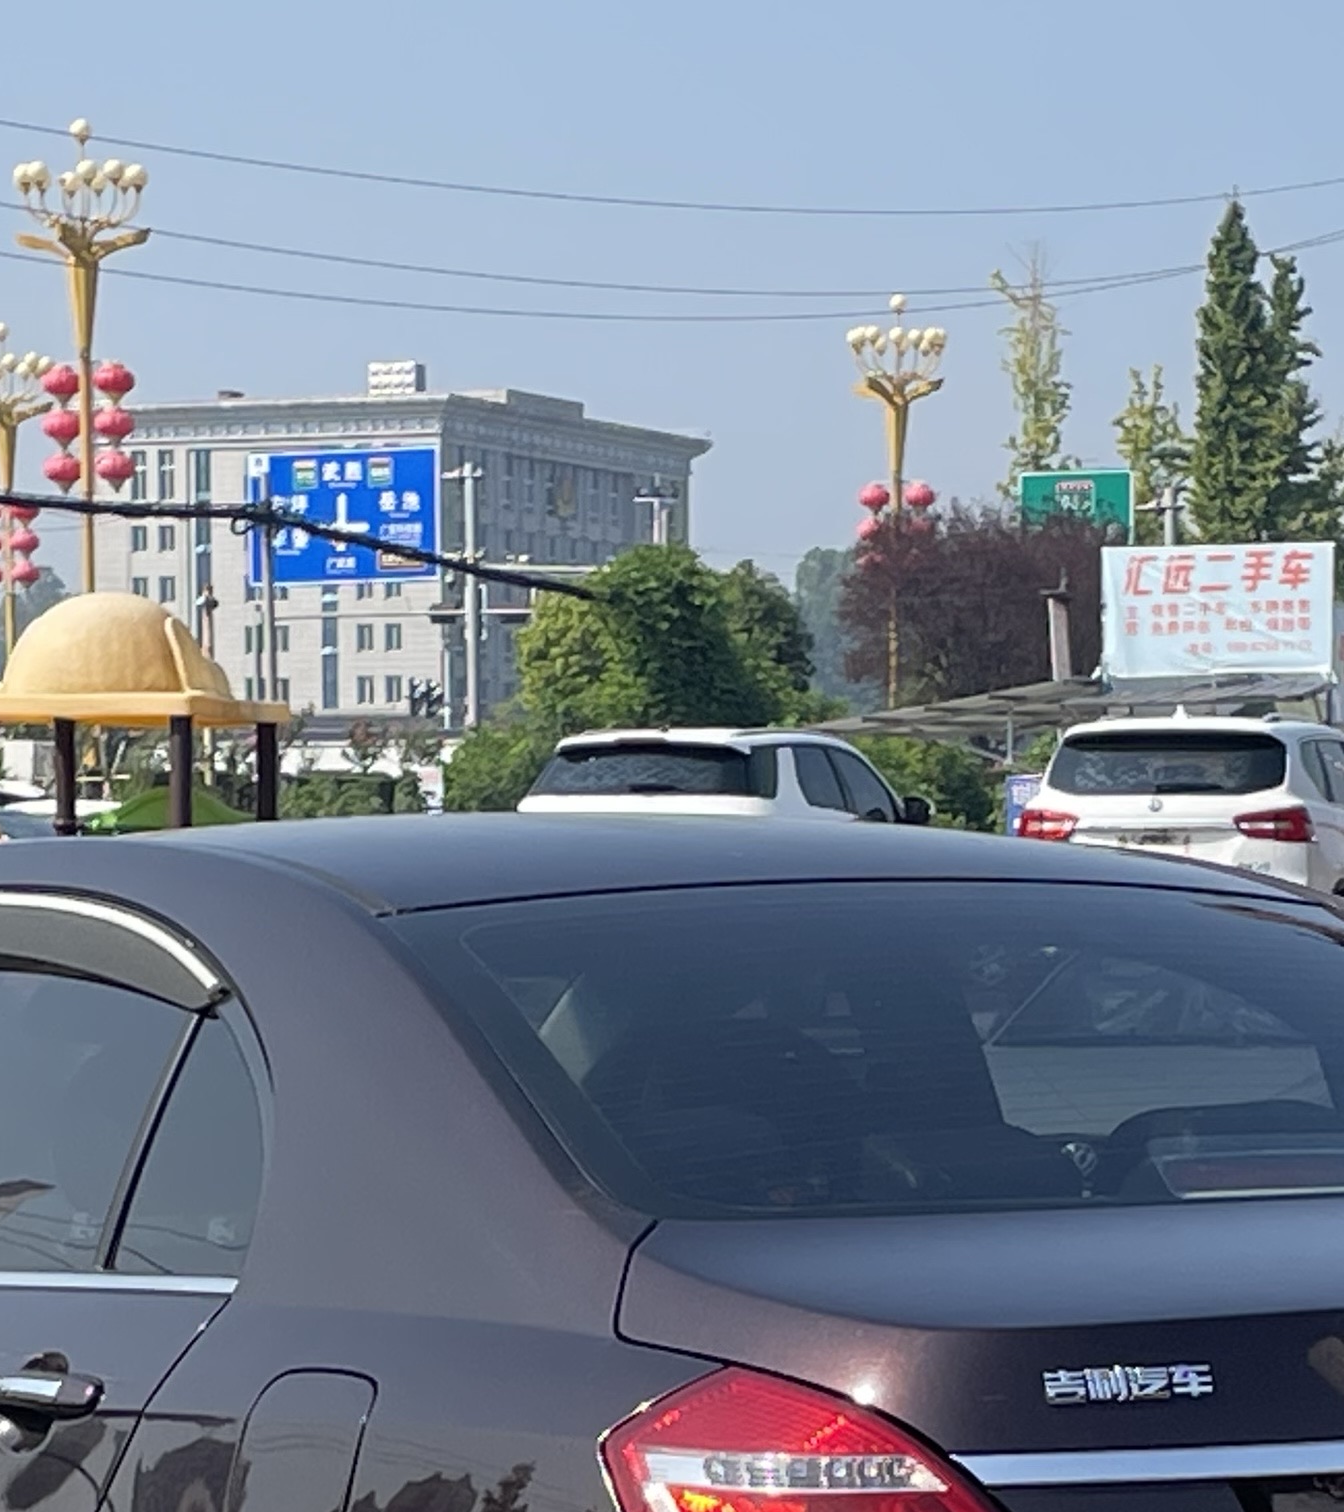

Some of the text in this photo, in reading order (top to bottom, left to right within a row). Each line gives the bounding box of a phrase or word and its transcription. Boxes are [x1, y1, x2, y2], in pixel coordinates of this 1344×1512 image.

[1122, 550, 1315, 596] 汇远二手车
[1043, 1364, 1213, 1405] 吉利汽车
